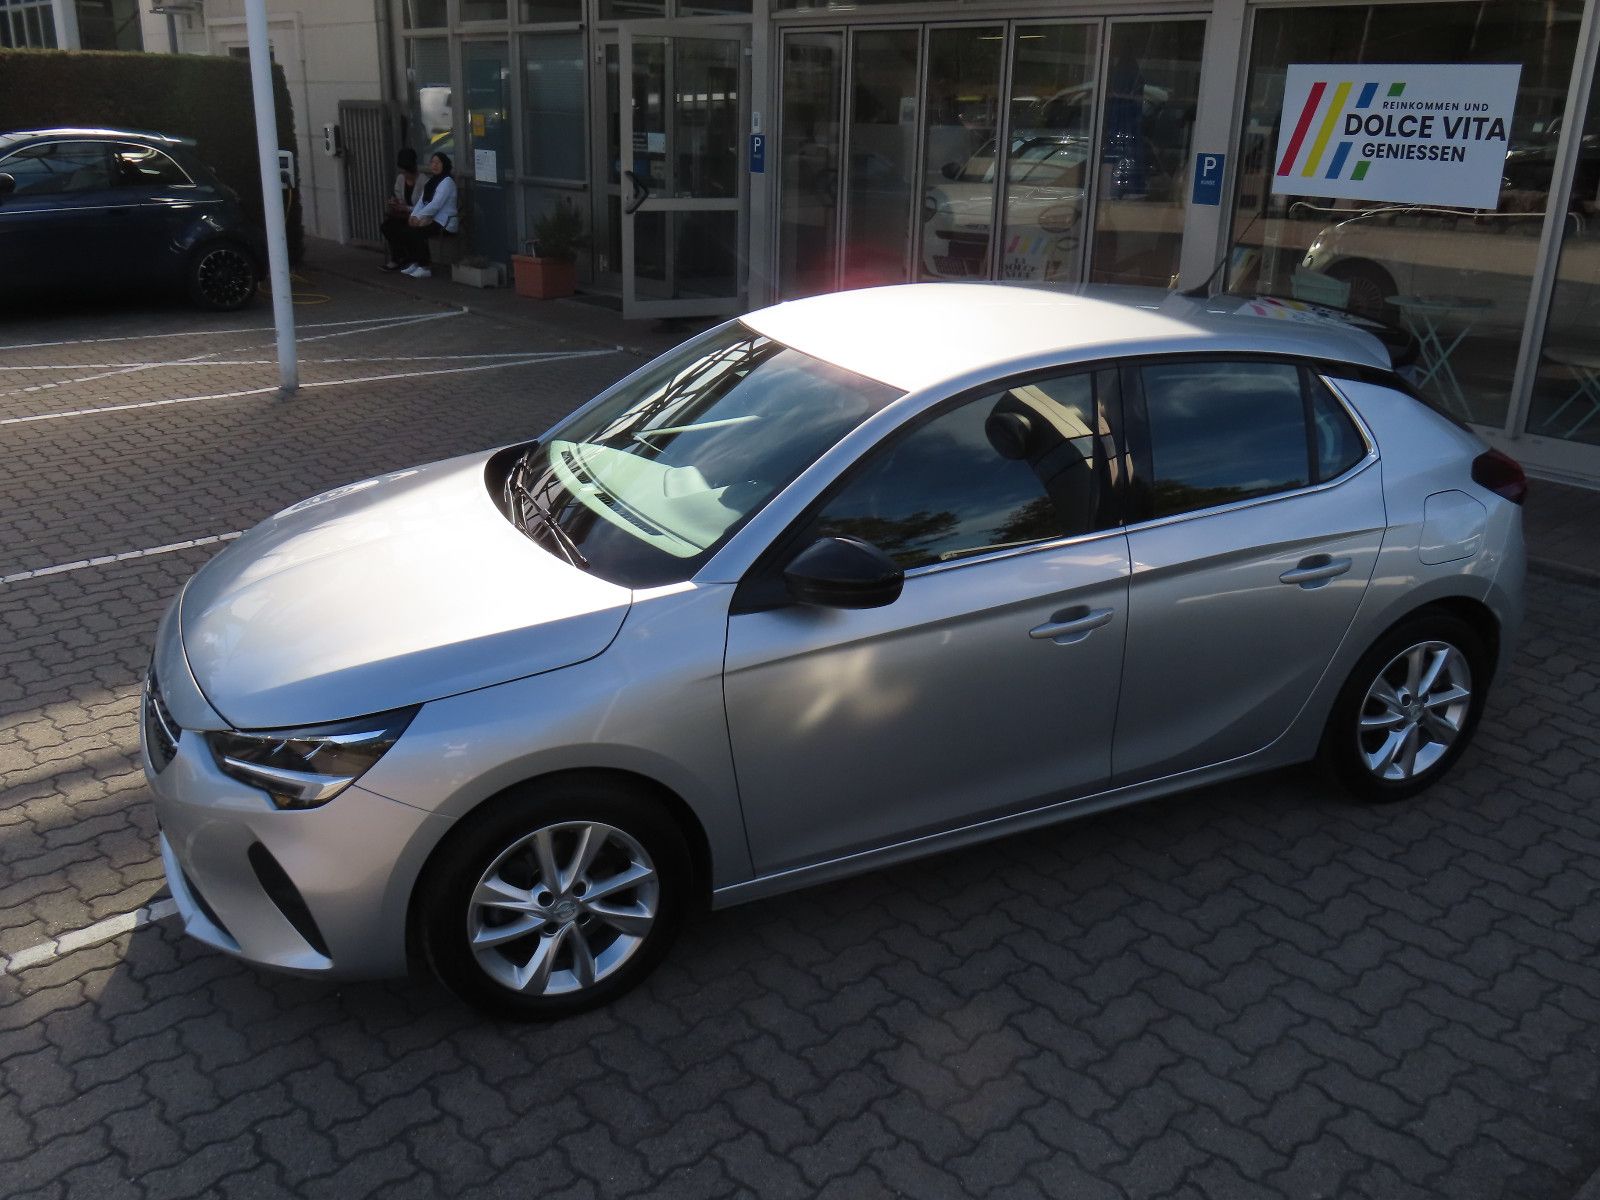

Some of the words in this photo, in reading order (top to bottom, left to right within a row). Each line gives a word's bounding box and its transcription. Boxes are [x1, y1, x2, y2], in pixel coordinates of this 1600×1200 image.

[1382, 101, 1459, 111] REINKOMMEN
[1464, 103, 1489, 111] UND
[1344, 113, 1434, 138] DOLCE
[1443, 116, 1506, 141] VITA
[754, 136, 761, 152] P
[1362, 142, 1466, 162] GENIESSEN
[1203, 156, 1217, 177] P
